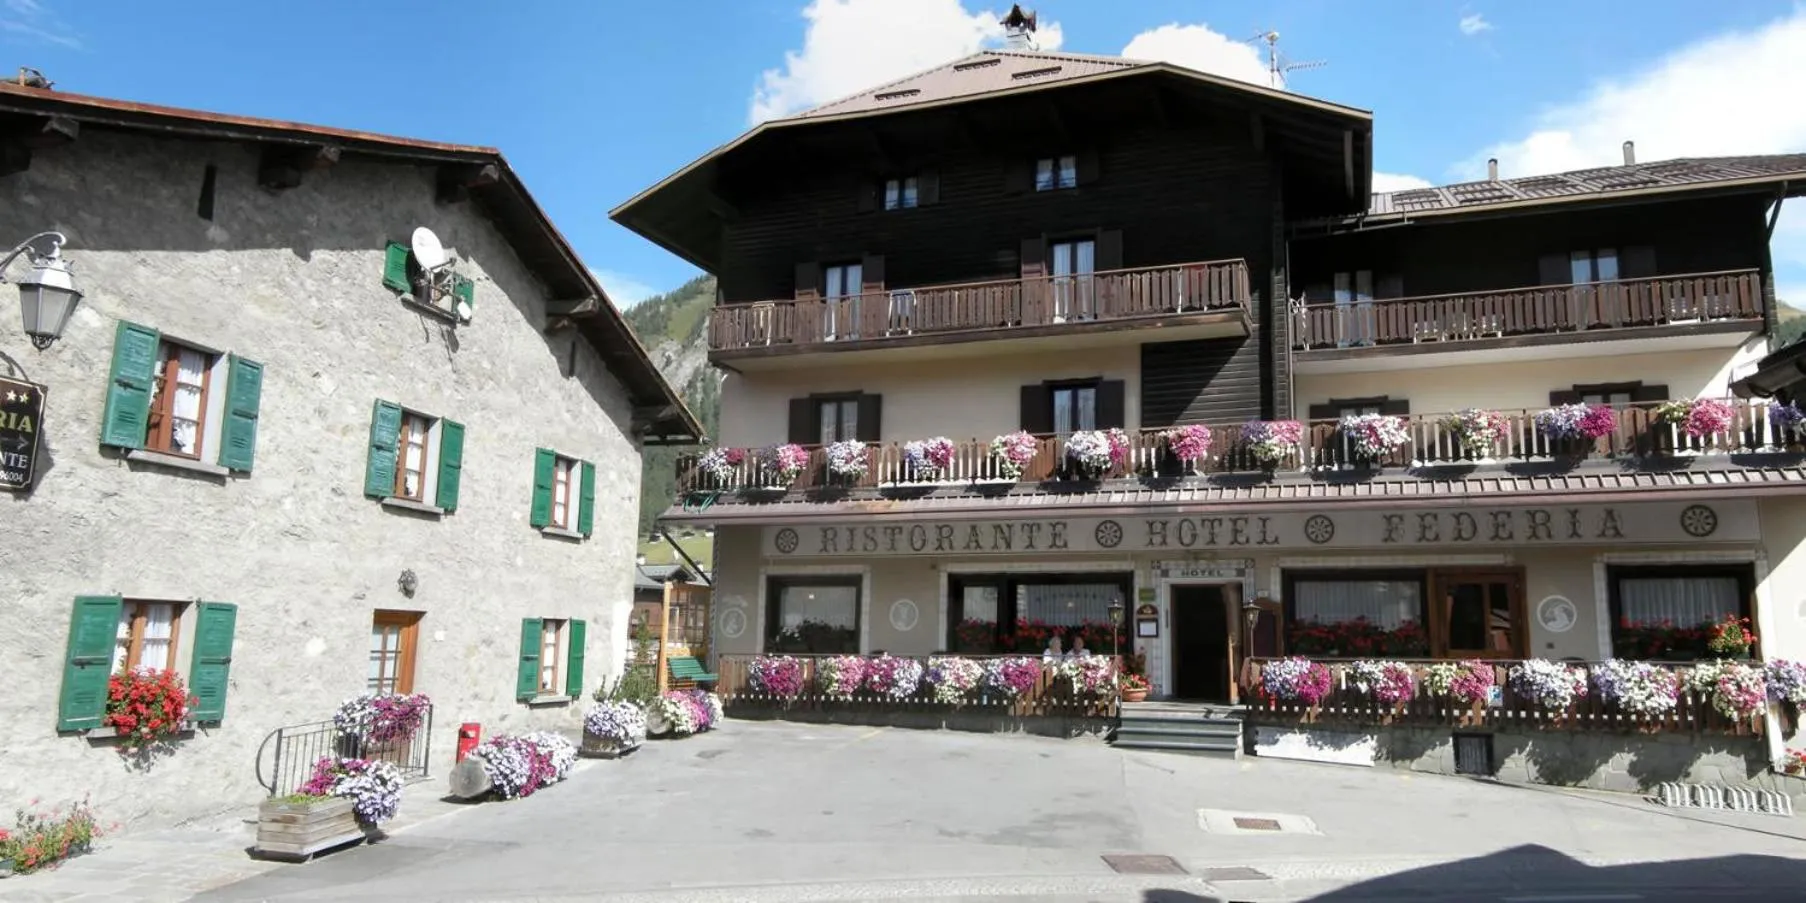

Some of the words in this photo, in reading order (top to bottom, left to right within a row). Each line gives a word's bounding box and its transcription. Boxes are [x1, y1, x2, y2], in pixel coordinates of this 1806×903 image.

[818, 521, 1069, 553] RISTORANTE
[1145, 517, 1280, 547] HOTEL
[1381, 508, 1624, 543] FEDERIA
[1181, 568, 1224, 577] HOTEL
